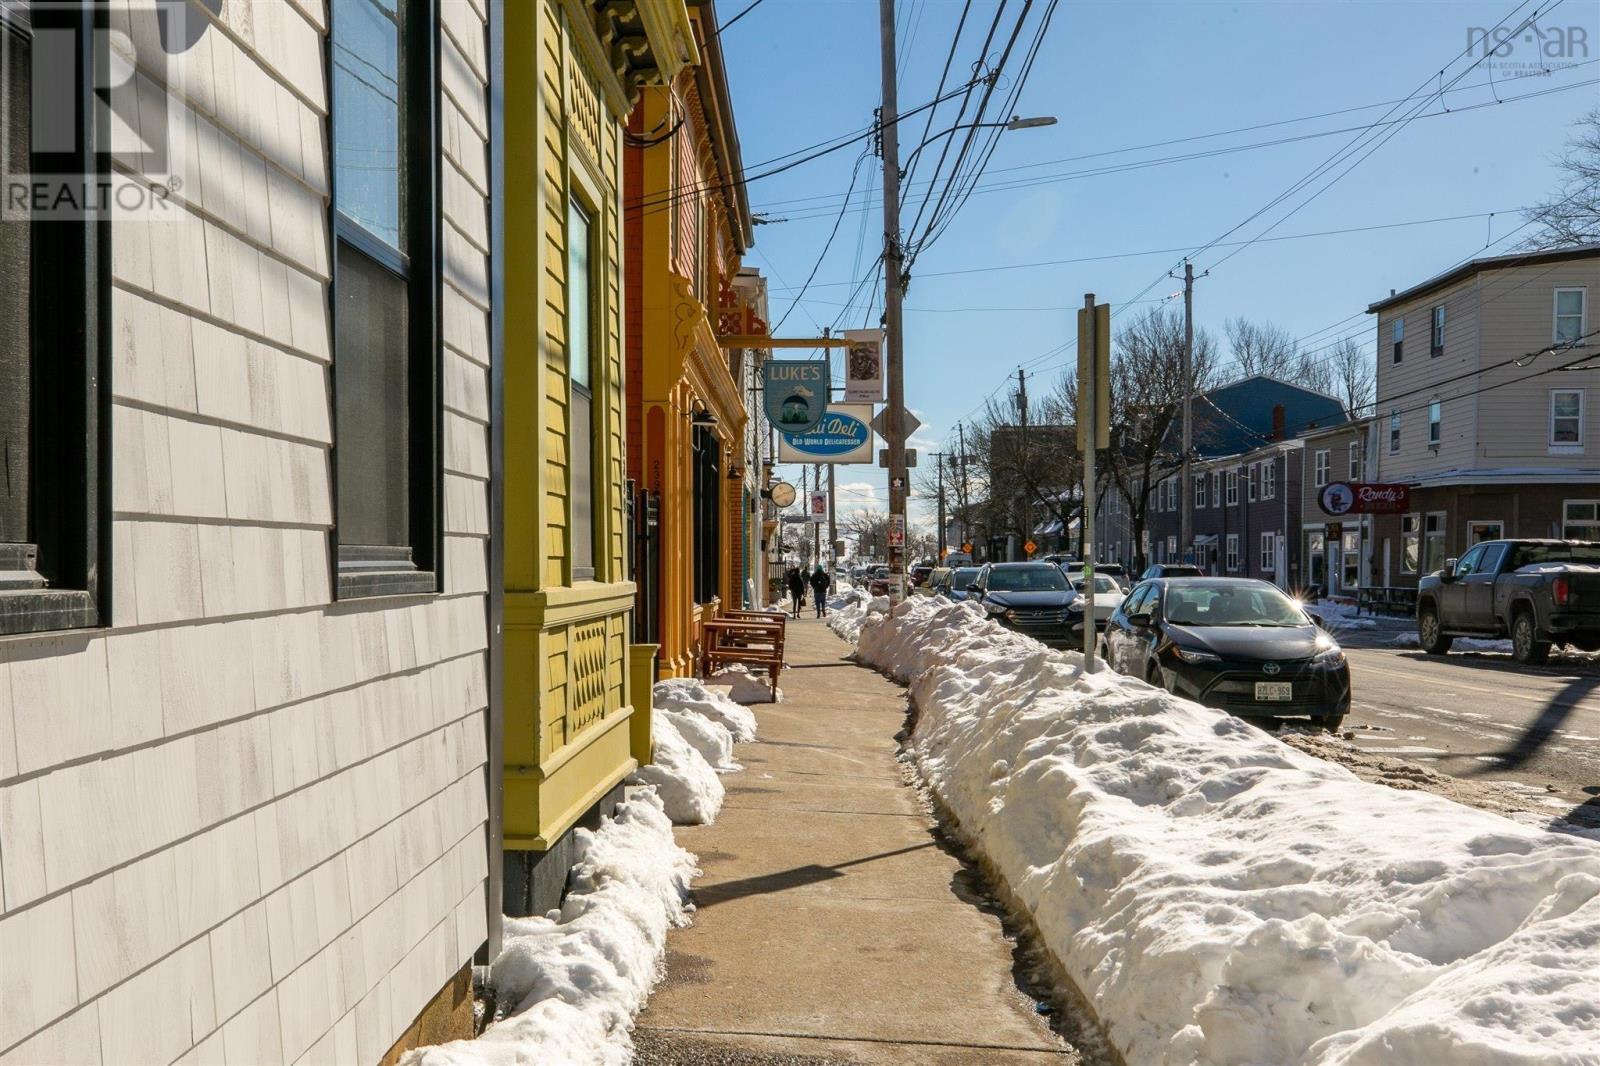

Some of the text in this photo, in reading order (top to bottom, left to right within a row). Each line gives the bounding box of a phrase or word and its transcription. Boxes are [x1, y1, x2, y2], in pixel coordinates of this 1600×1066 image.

[771, 366, 820, 380] LUKE'S
[828, 418, 860, 437] Deli
[1359, 486, 1405, 502] Randy's
